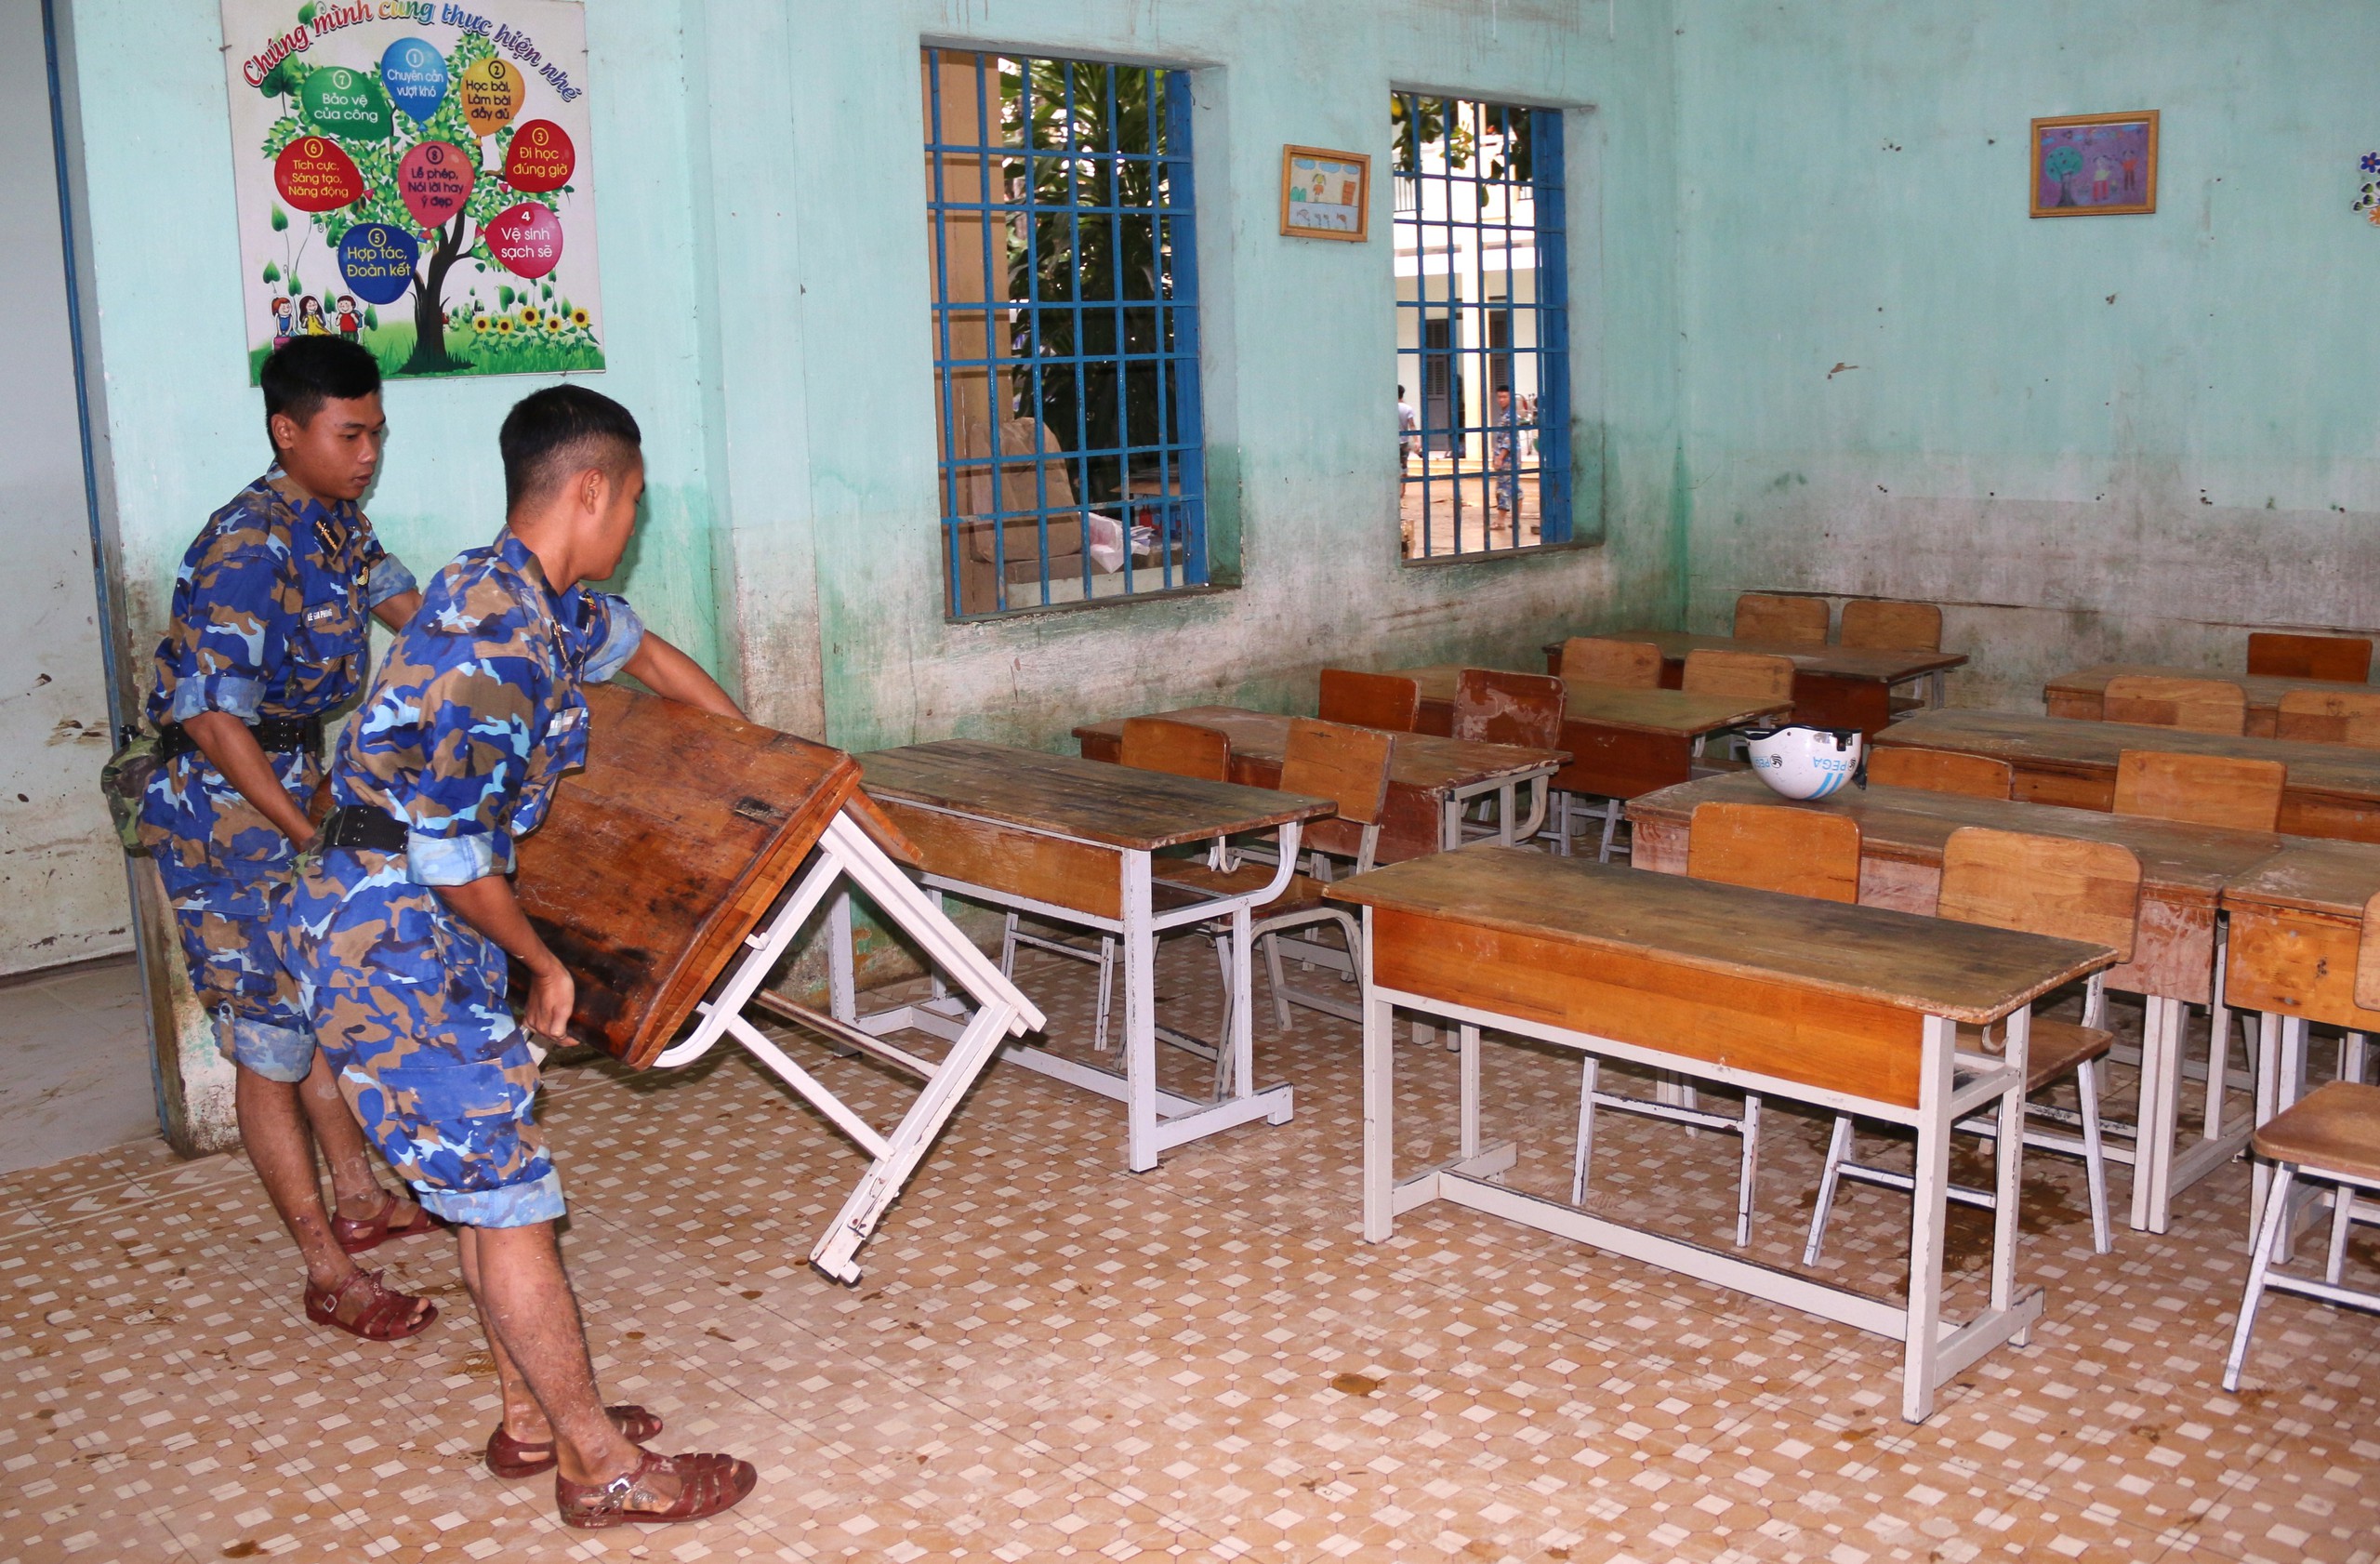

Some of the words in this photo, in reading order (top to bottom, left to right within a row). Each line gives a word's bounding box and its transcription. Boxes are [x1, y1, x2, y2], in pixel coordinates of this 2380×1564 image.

[243, 24, 311, 86] Chúng
[312, 0, 373, 35] mình
[378, 0, 435, 23] cùng
[441, 3, 492, 35] thực
[493, 23, 541, 66] hiện
[539, 62, 582, 102] nhé
[387, 69, 423, 84] Chuyên
[396, 86, 417, 99] vượt
[419, 86, 437, 98] khó
[466, 80, 488, 93] Học
[322, 92, 349, 105] Bảo
[350, 94, 368, 108] vệ
[468, 94, 492, 105] Làm
[493, 95, 511, 106] bài
[313, 106, 341, 120] của
[343, 109, 378, 124] công
[495, 108, 509, 120] đủ
[520, 147, 532, 159] Đi
[535, 147, 560, 162] học
[293, 159, 314, 170] Tích
[512, 162, 546, 178] đúng
[549, 163, 568, 178] giờ
[292, 172, 319, 185] Sáng
[322, 173, 343, 185] tạo,
[427, 167, 458, 181] phép,
[288, 186, 318, 198] Năng
[320, 186, 349, 198] động
[408, 181, 426, 192] Nói
[443, 182, 464, 194] hay
[421, 195, 428, 209] ý
[430, 195, 454, 208] đẹp
[521, 210, 531, 221] 4
[500, 227, 522, 244] Vệ
[524, 227, 550, 241] sinh
[347, 245, 377, 262] Hợp
[379, 245, 407, 260] tác,
[501, 245, 535, 260] sạch
[347, 263, 387, 277] Đoàn
[389, 261, 411, 277] kết
[1755, 759, 1770, 768] PEG
[1813, 757, 1847, 771] PEGA
